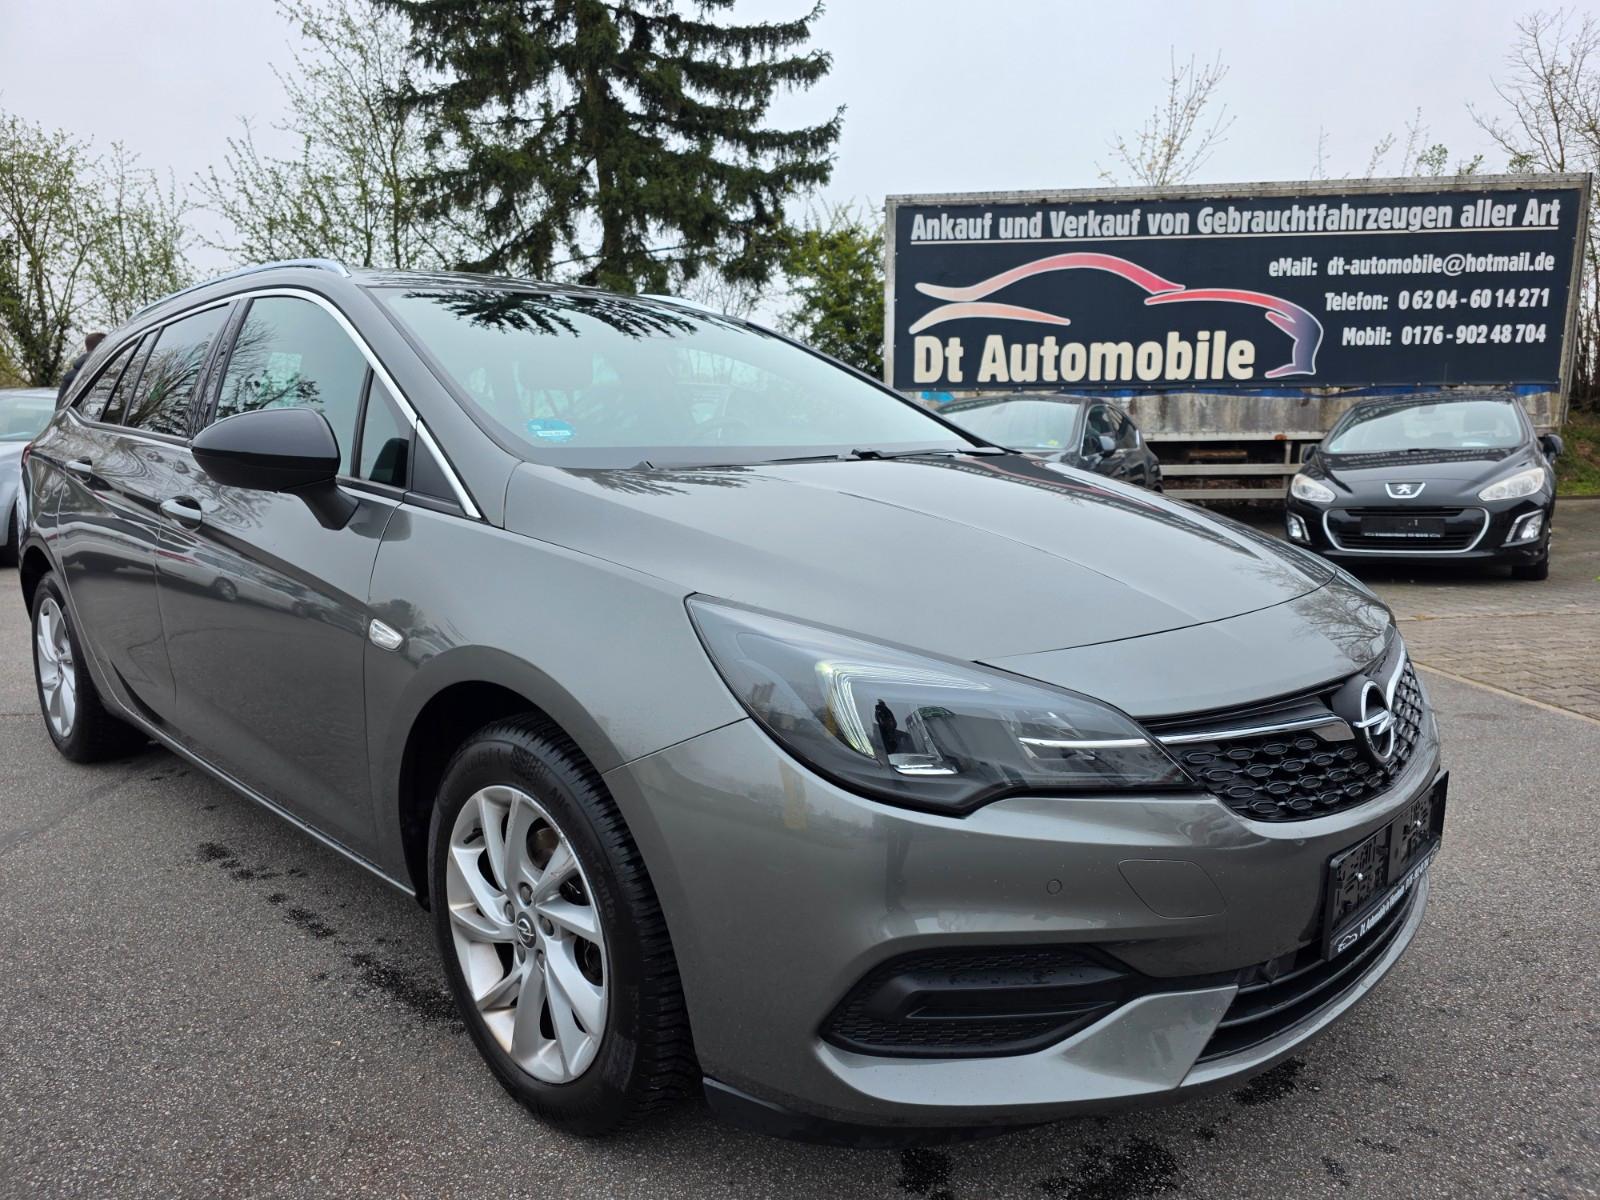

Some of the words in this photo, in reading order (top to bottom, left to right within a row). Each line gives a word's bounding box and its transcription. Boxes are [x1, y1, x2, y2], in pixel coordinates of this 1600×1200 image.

[911, 213, 992, 240] Ankauf
[999, 212, 1043, 239] und
[1049, 209, 1142, 238] Verkauf
[1147, 213, 1190, 236] von
[1196, 203, 1453, 234] Gebrauchtfahrzeugen
[1460, 199, 1517, 228] aller
[1522, 199, 1560, 225] Art
[1269, 257, 1317, 276] eMail:
[1328, 252, 1554, 276] dt-automobile@hotmail.de
[1325, 292, 1388, 311] Telefon:
[1342, 327, 1391, 345] Mobil:
[914, 335, 963, 383] Dt
[977, 331, 1255, 382] Automobile
